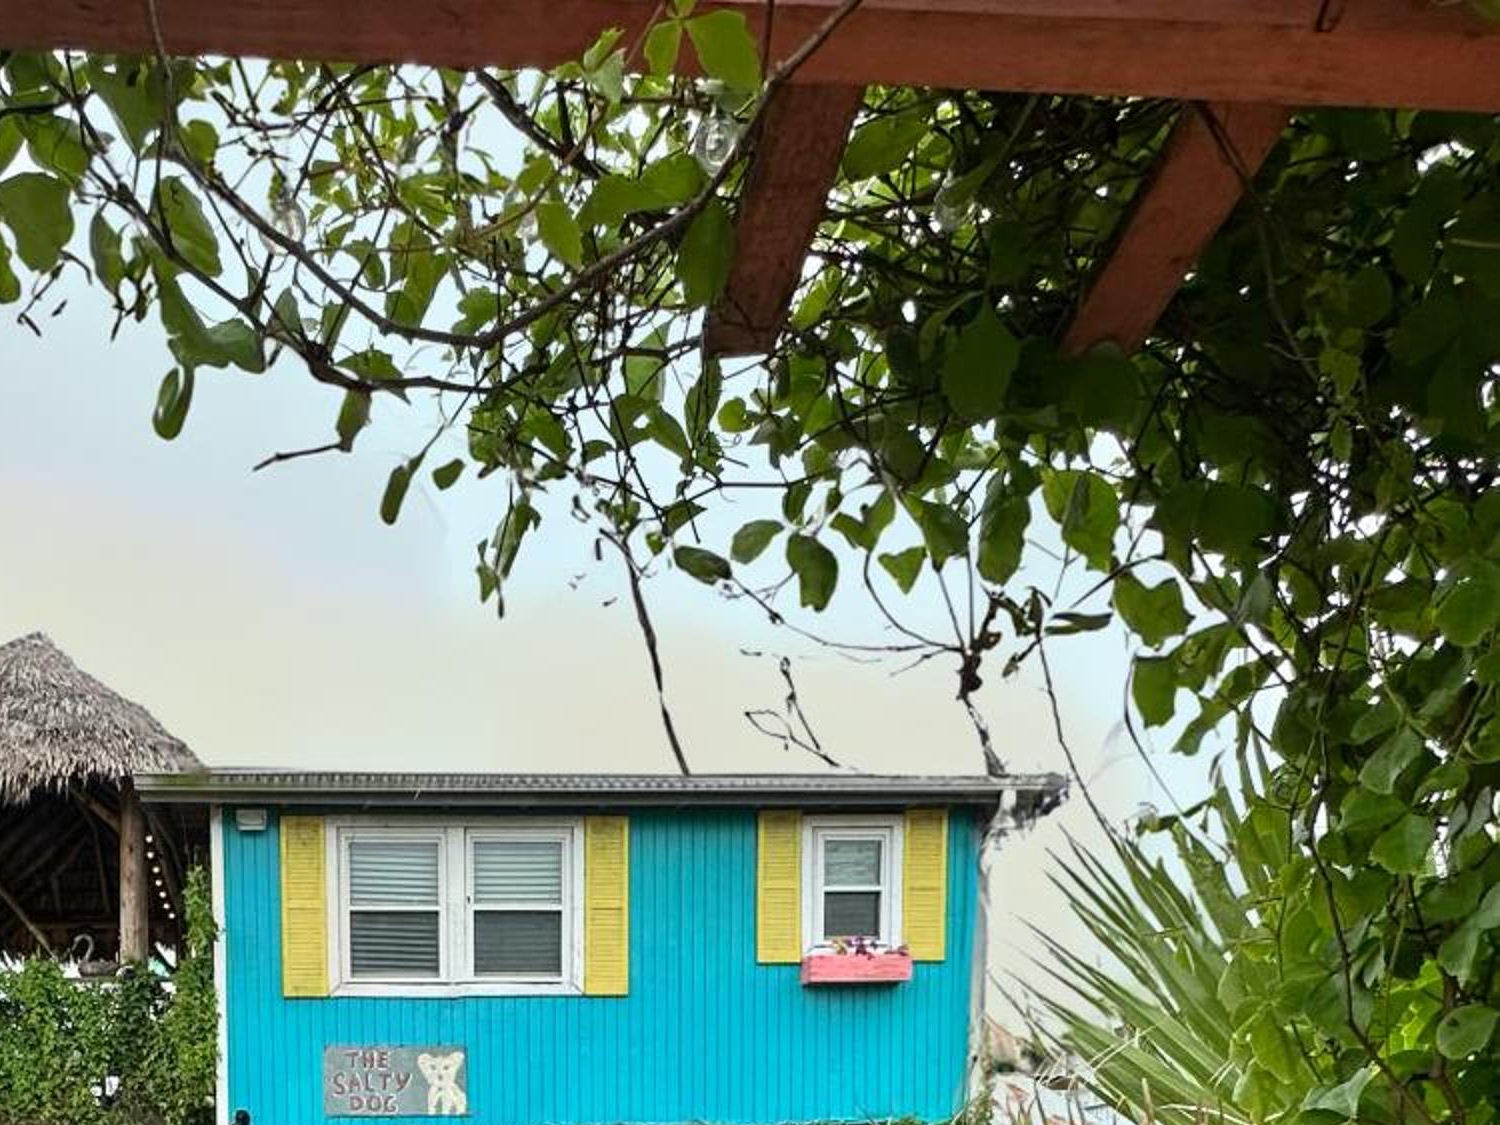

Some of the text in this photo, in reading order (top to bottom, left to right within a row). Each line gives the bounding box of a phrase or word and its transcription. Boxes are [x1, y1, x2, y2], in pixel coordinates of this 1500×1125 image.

[346, 1050, 390, 1069] THE
[333, 1072, 412, 1096] SALTY
[349, 1095, 398, 1113] DOG
